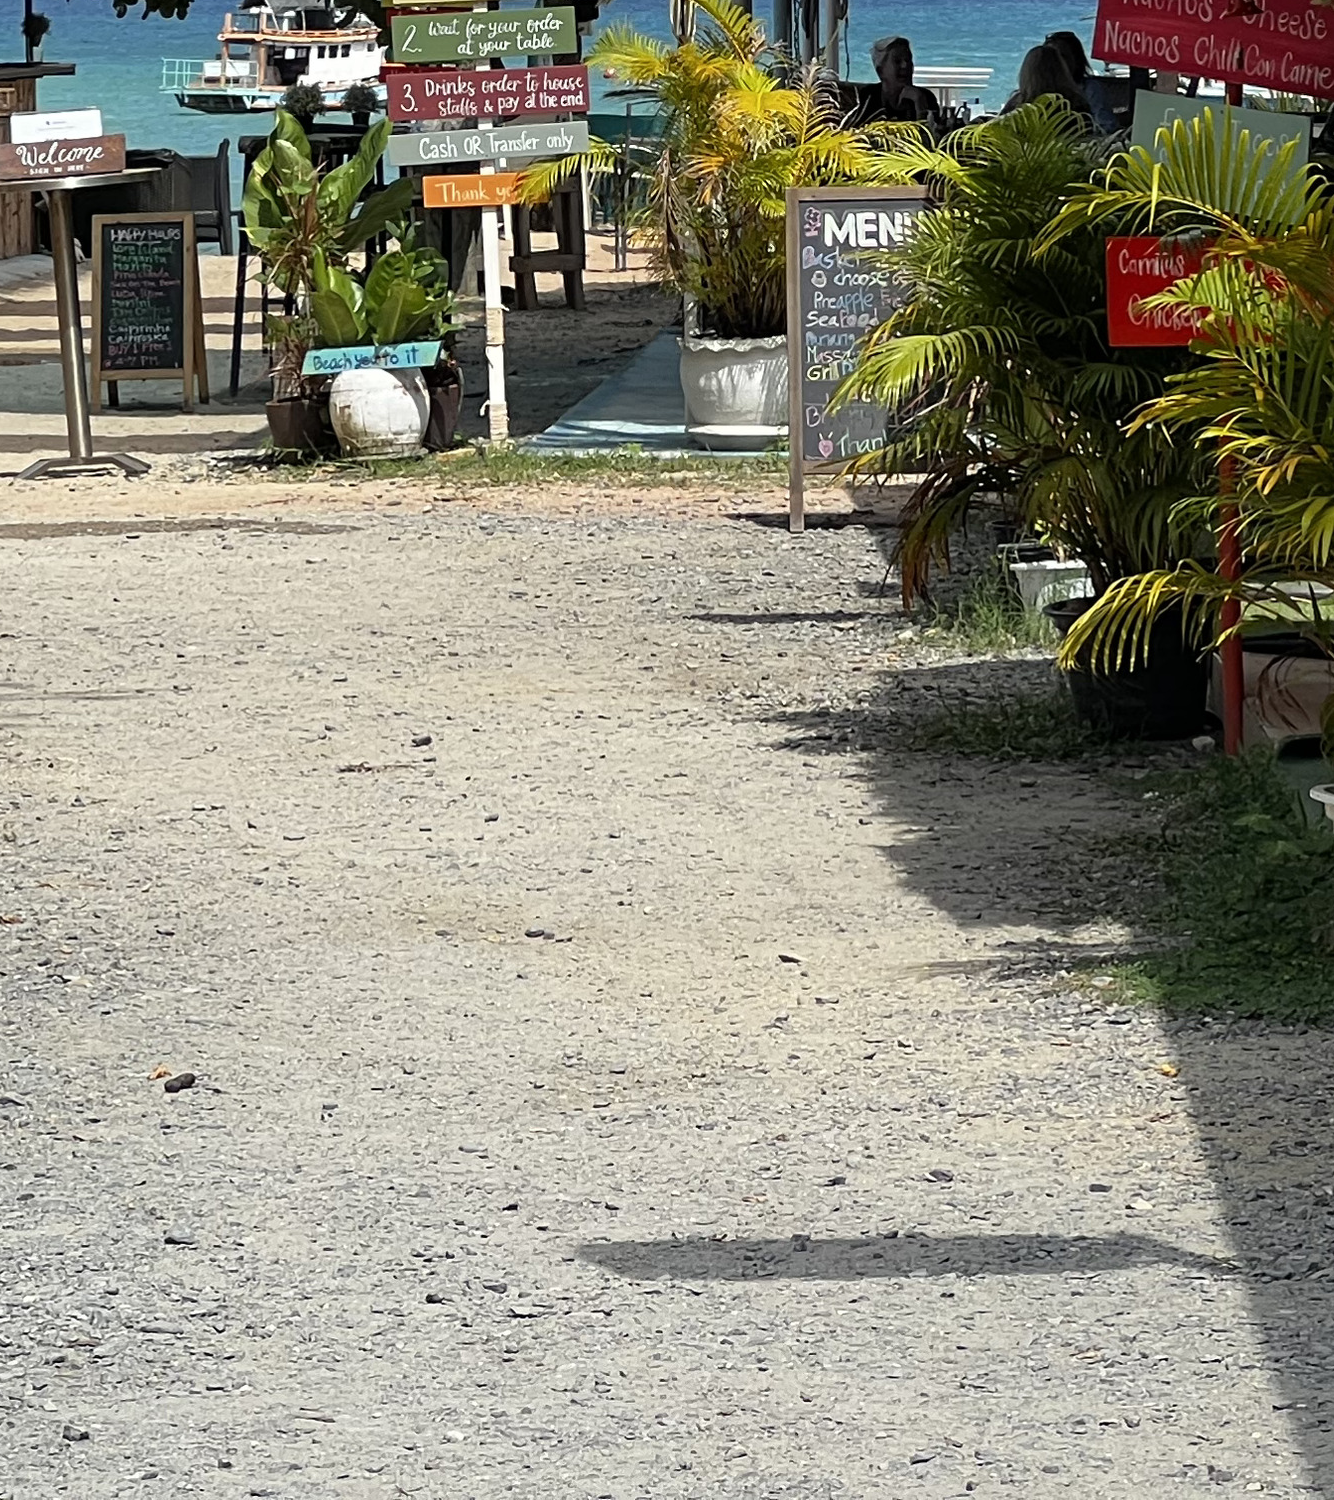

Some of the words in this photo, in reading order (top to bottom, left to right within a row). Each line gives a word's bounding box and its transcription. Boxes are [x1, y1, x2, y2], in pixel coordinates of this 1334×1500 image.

[401, 24, 422, 53] 2.
[428, 19, 460, 37] Wait
[465, 18, 487, 40] for
[487, 20, 520, 38] your
[527, 13, 564, 33] order
[457, 38, 474, 56] at
[478, 39, 511, 56] your
[1104, 20, 1180, 64] Nachos
[1244, 44, 1275, 76] Con
[1281, 52, 1334, 90] Carne
[400, 83, 418, 112] 3.
[425, 75, 476, 97] Drinks
[482, 74, 522, 92] order
[524, 72, 539, 92] to
[543, 72, 584, 91] house
[484, 100, 494, 114] &
[498, 96, 519, 115] pay
[524, 93, 537, 109] at
[539, 91, 558, 108] the
[16, 141, 105, 166] Welcome
[419, 136, 457, 160] Cash
[464, 135, 484, 156] OR
[486, 131, 540, 153] Transfer
[546, 128, 574, 152] only
[435, 181, 490, 203] Thank
[313, 352, 353, 371] Beach
[381, 351, 399, 367] to
[406, 346, 420, 364] it
